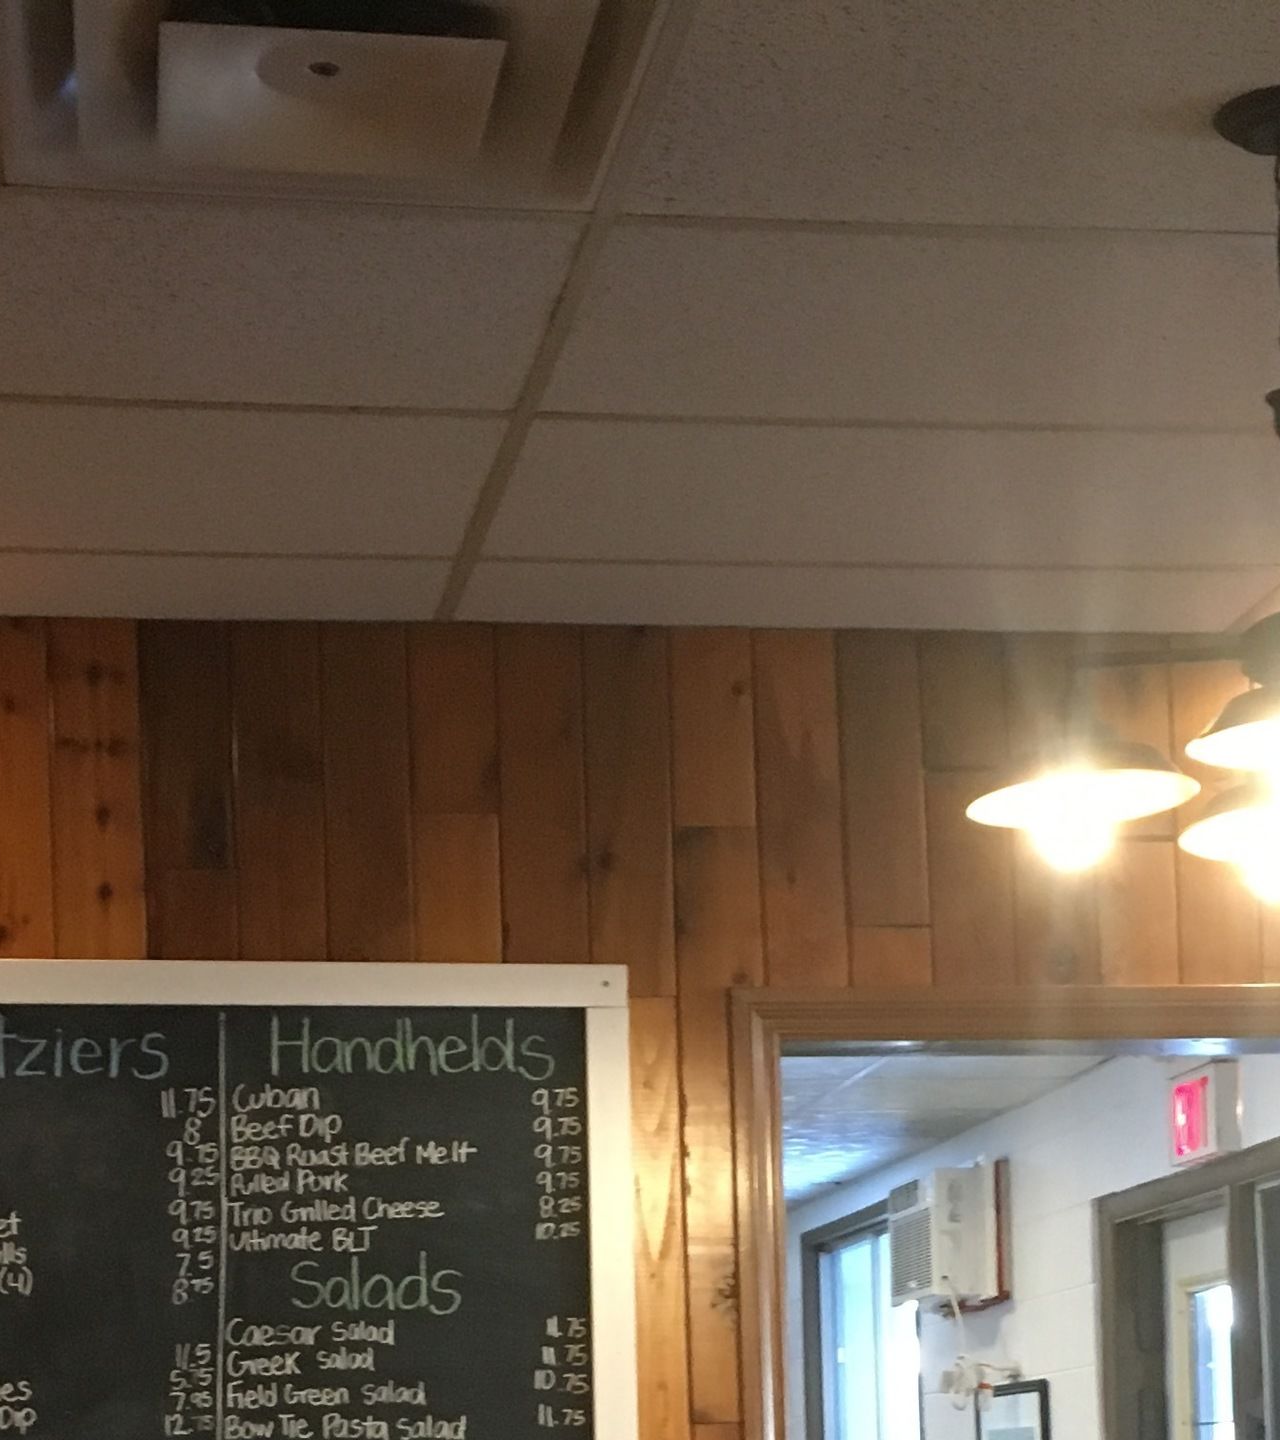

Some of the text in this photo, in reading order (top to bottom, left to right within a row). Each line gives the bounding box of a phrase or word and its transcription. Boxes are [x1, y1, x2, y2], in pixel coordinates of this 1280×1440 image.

[271, 1013, 555, 1080] Handhelds
[232, 1084, 320, 1111] Cuban
[183, 1117, 201, 1144] 8
[230, 1113, 343, 1143] Beef Dip
[230, 1137, 478, 1170] BBQ Roast Beef Melt
[230, 1170, 350, 1195] Pulled Pork
[227, 1196, 445, 1227] Trio Grilled Cheese
[332, 1225, 378, 1252] BLT
[290, 1250, 464, 1315] Salads
[226, 1318, 321, 1347] Caesar
[226, 1350, 302, 1377] Greek
[225, 1380, 350, 1408] Field Green
[224, 1414, 389, 1440] Bow Tie Pasta
